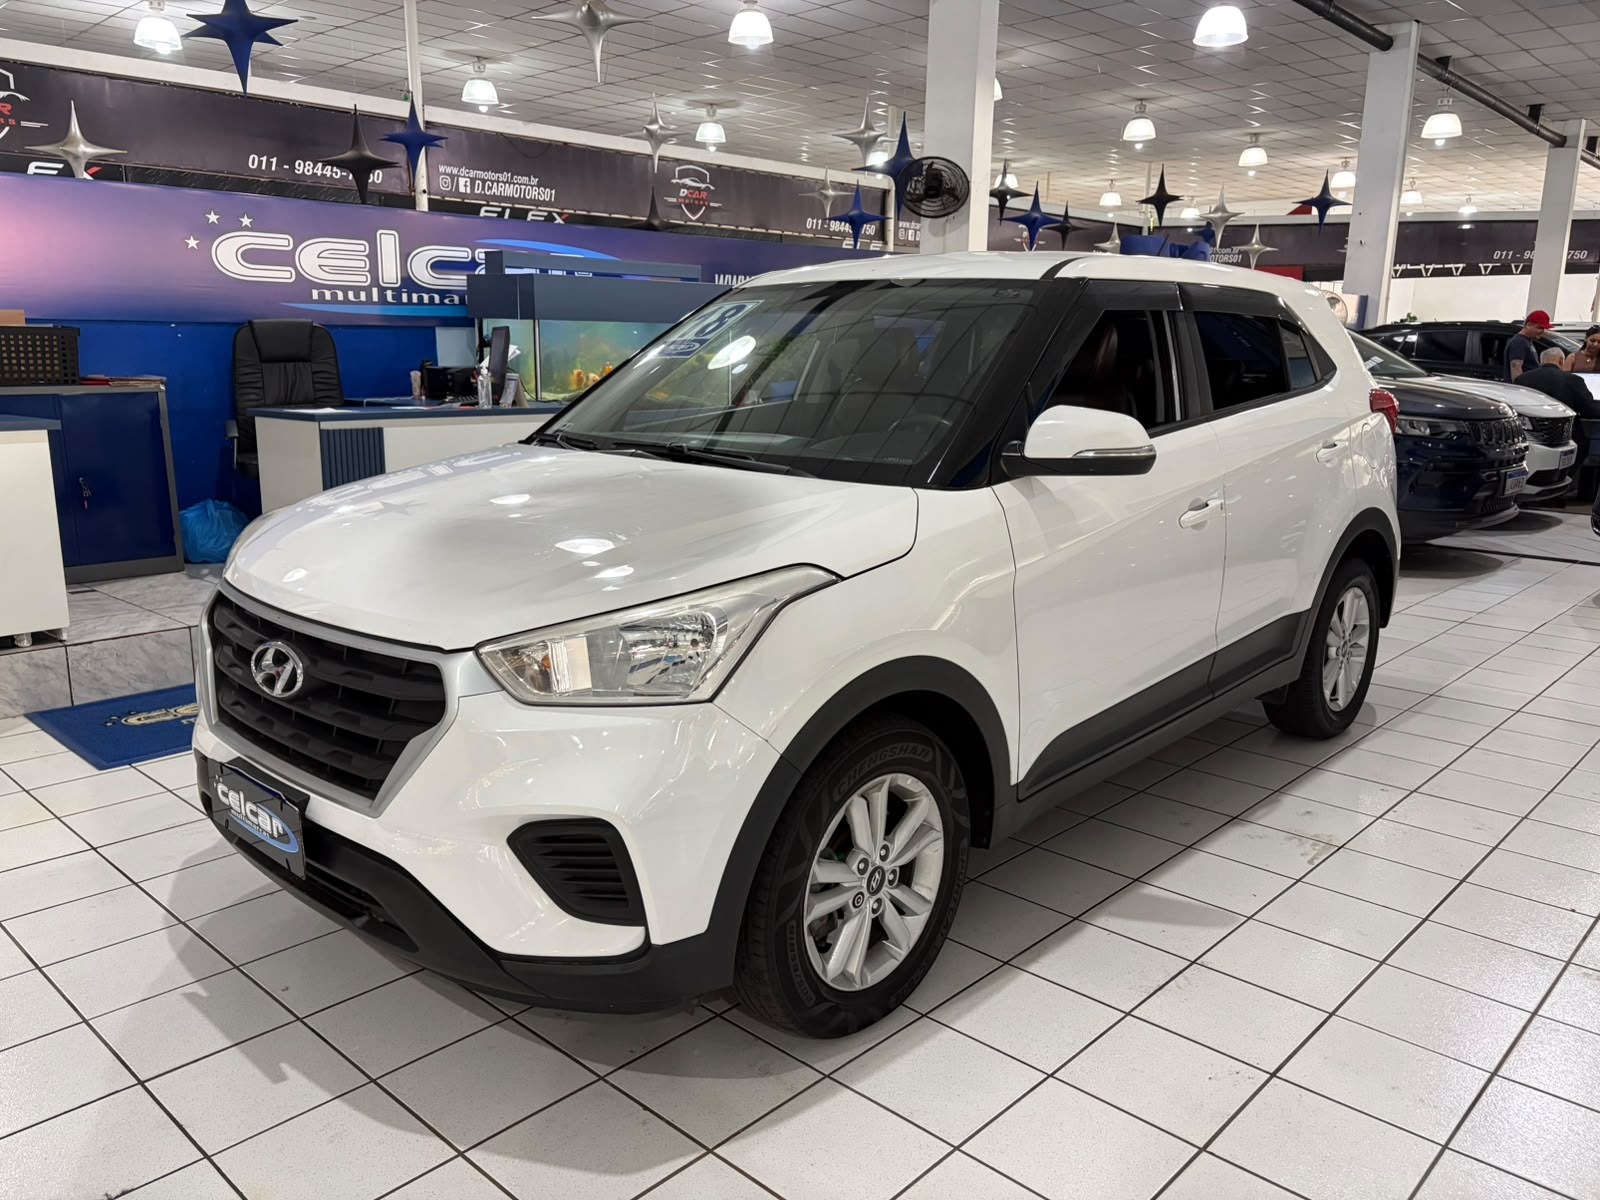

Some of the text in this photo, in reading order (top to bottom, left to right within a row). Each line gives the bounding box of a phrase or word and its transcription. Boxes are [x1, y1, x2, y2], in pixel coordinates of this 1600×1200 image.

[248, 154, 277, 171] 011
[438, 164, 540, 186] www.dcarmotors01.com.br
[474, 180, 556, 201] D.CARMOTORS01
[679, 188, 709, 199] DCAR
[806, 218, 822, 230] 011
[312, 286, 468, 305] multima
[217, 782, 284, 838] celcar
